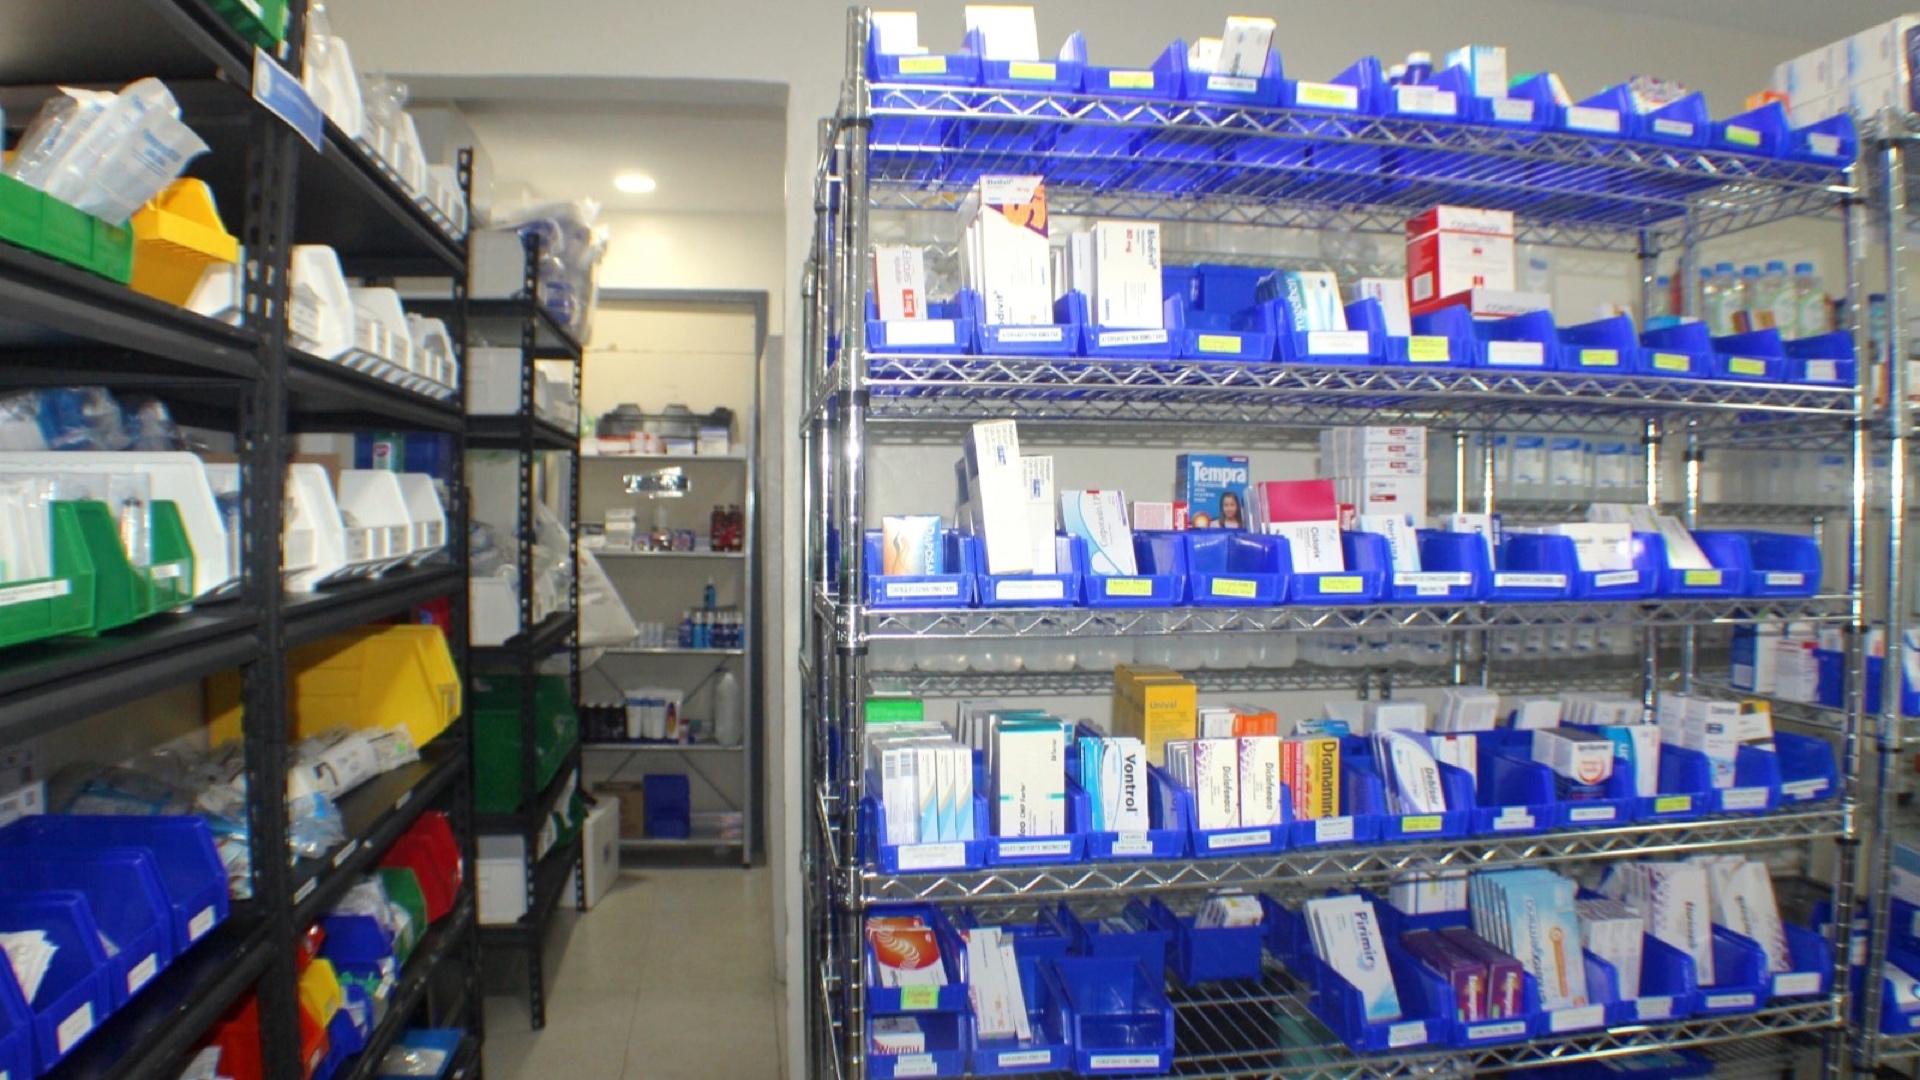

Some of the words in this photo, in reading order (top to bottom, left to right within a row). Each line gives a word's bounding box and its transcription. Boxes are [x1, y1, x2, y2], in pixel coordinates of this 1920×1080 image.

[1191, 461, 1247, 488] Tempra
[1150, 701, 1177, 710] Unival
[1124, 753, 1138, 813] Vontrol
[1354, 911, 1377, 963] Pirimir
